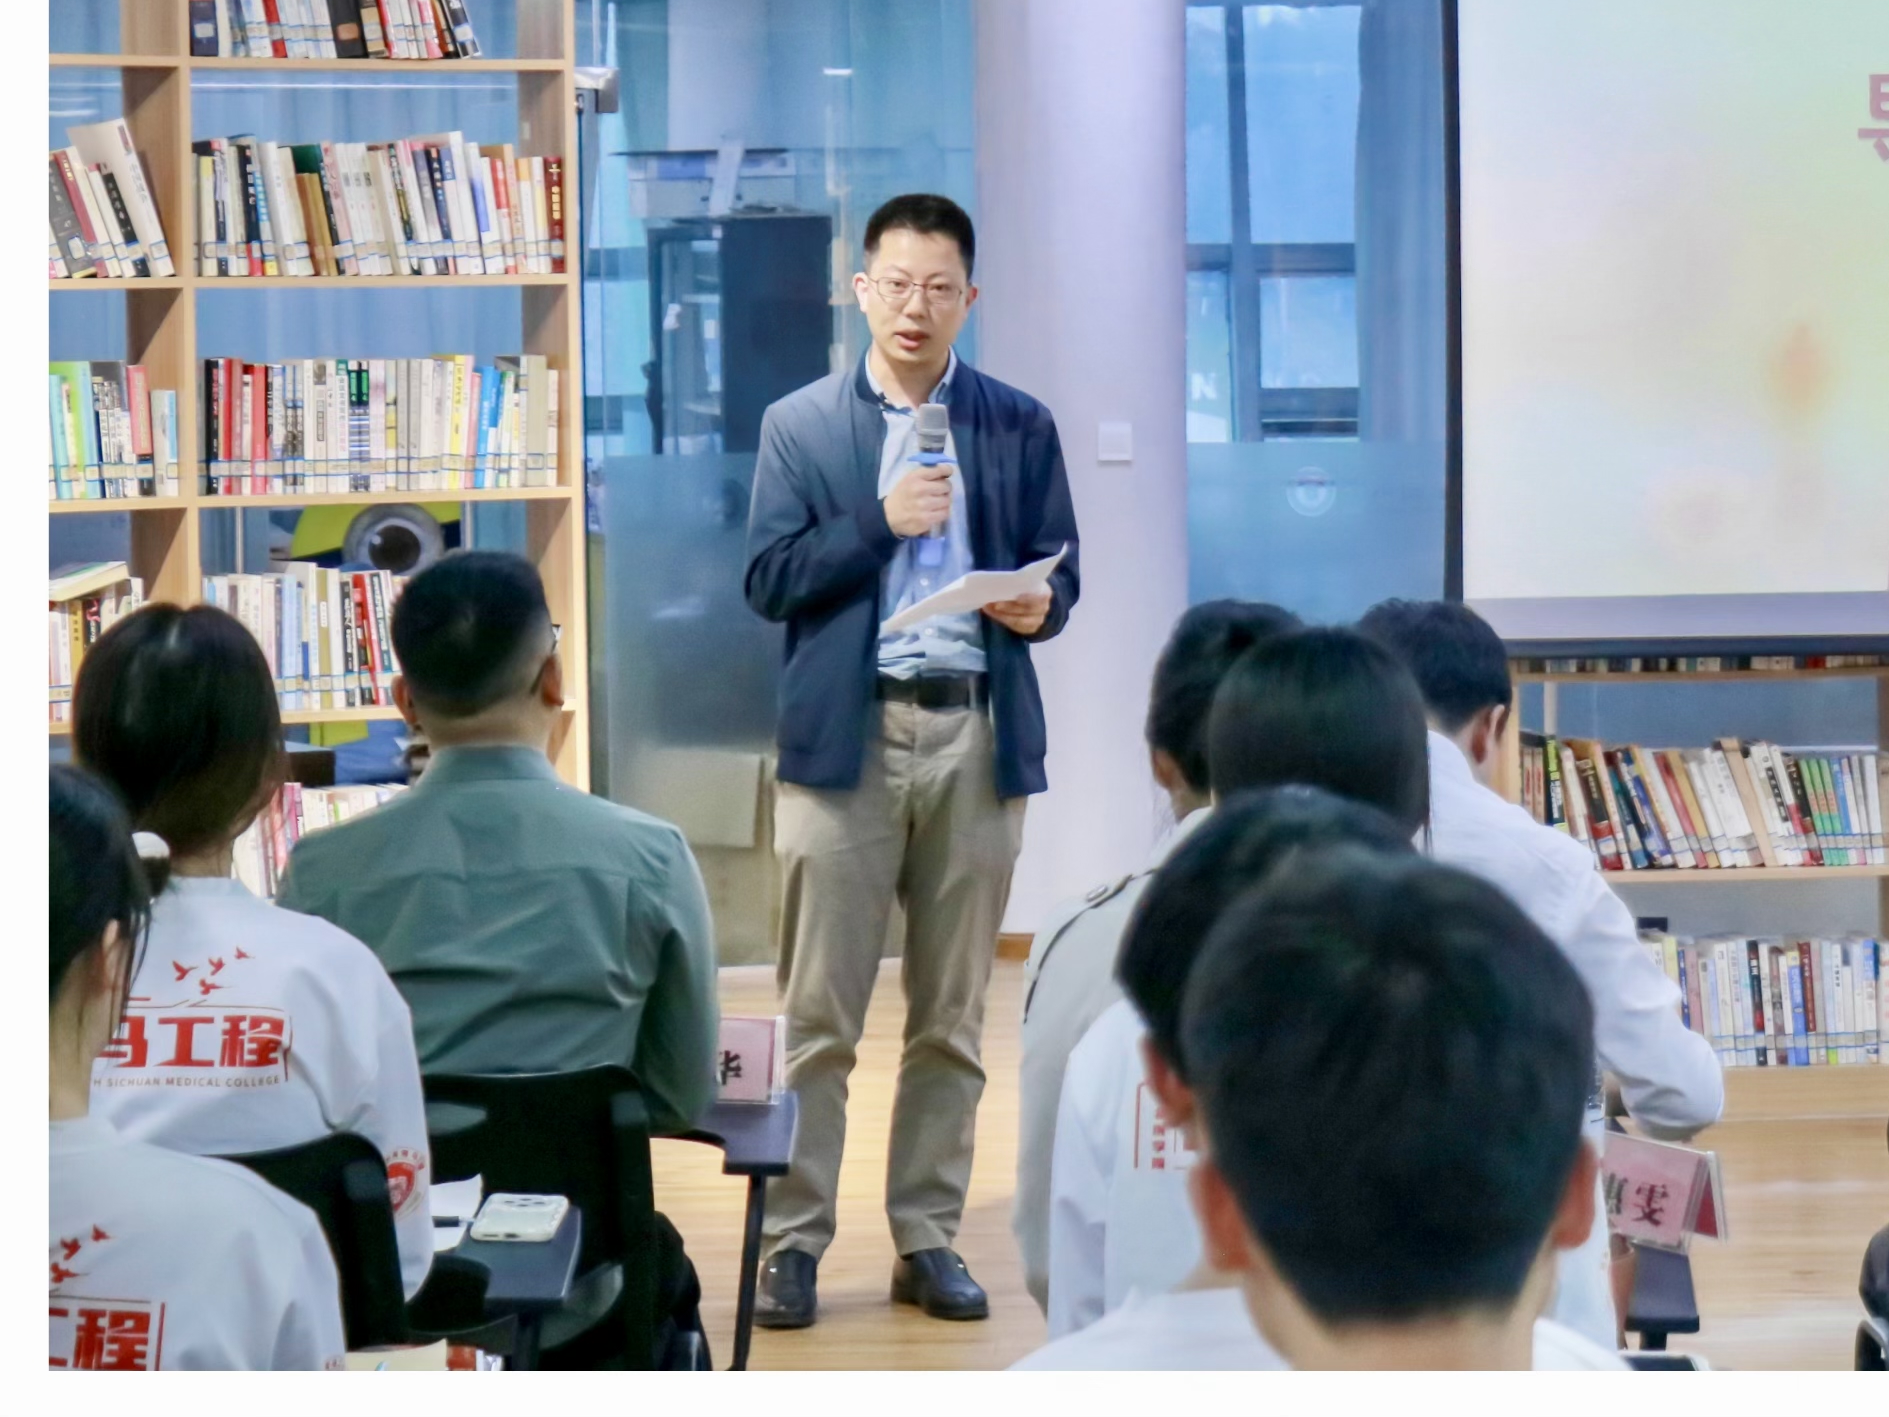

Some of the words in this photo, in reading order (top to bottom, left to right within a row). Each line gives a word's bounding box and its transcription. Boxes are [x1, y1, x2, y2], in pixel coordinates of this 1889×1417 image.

[107, 1077, 161, 1087] SICHUAN
[165, 1077, 221, 1088] MEDICAL
[225, 1075, 281, 1088] COLLEGE
